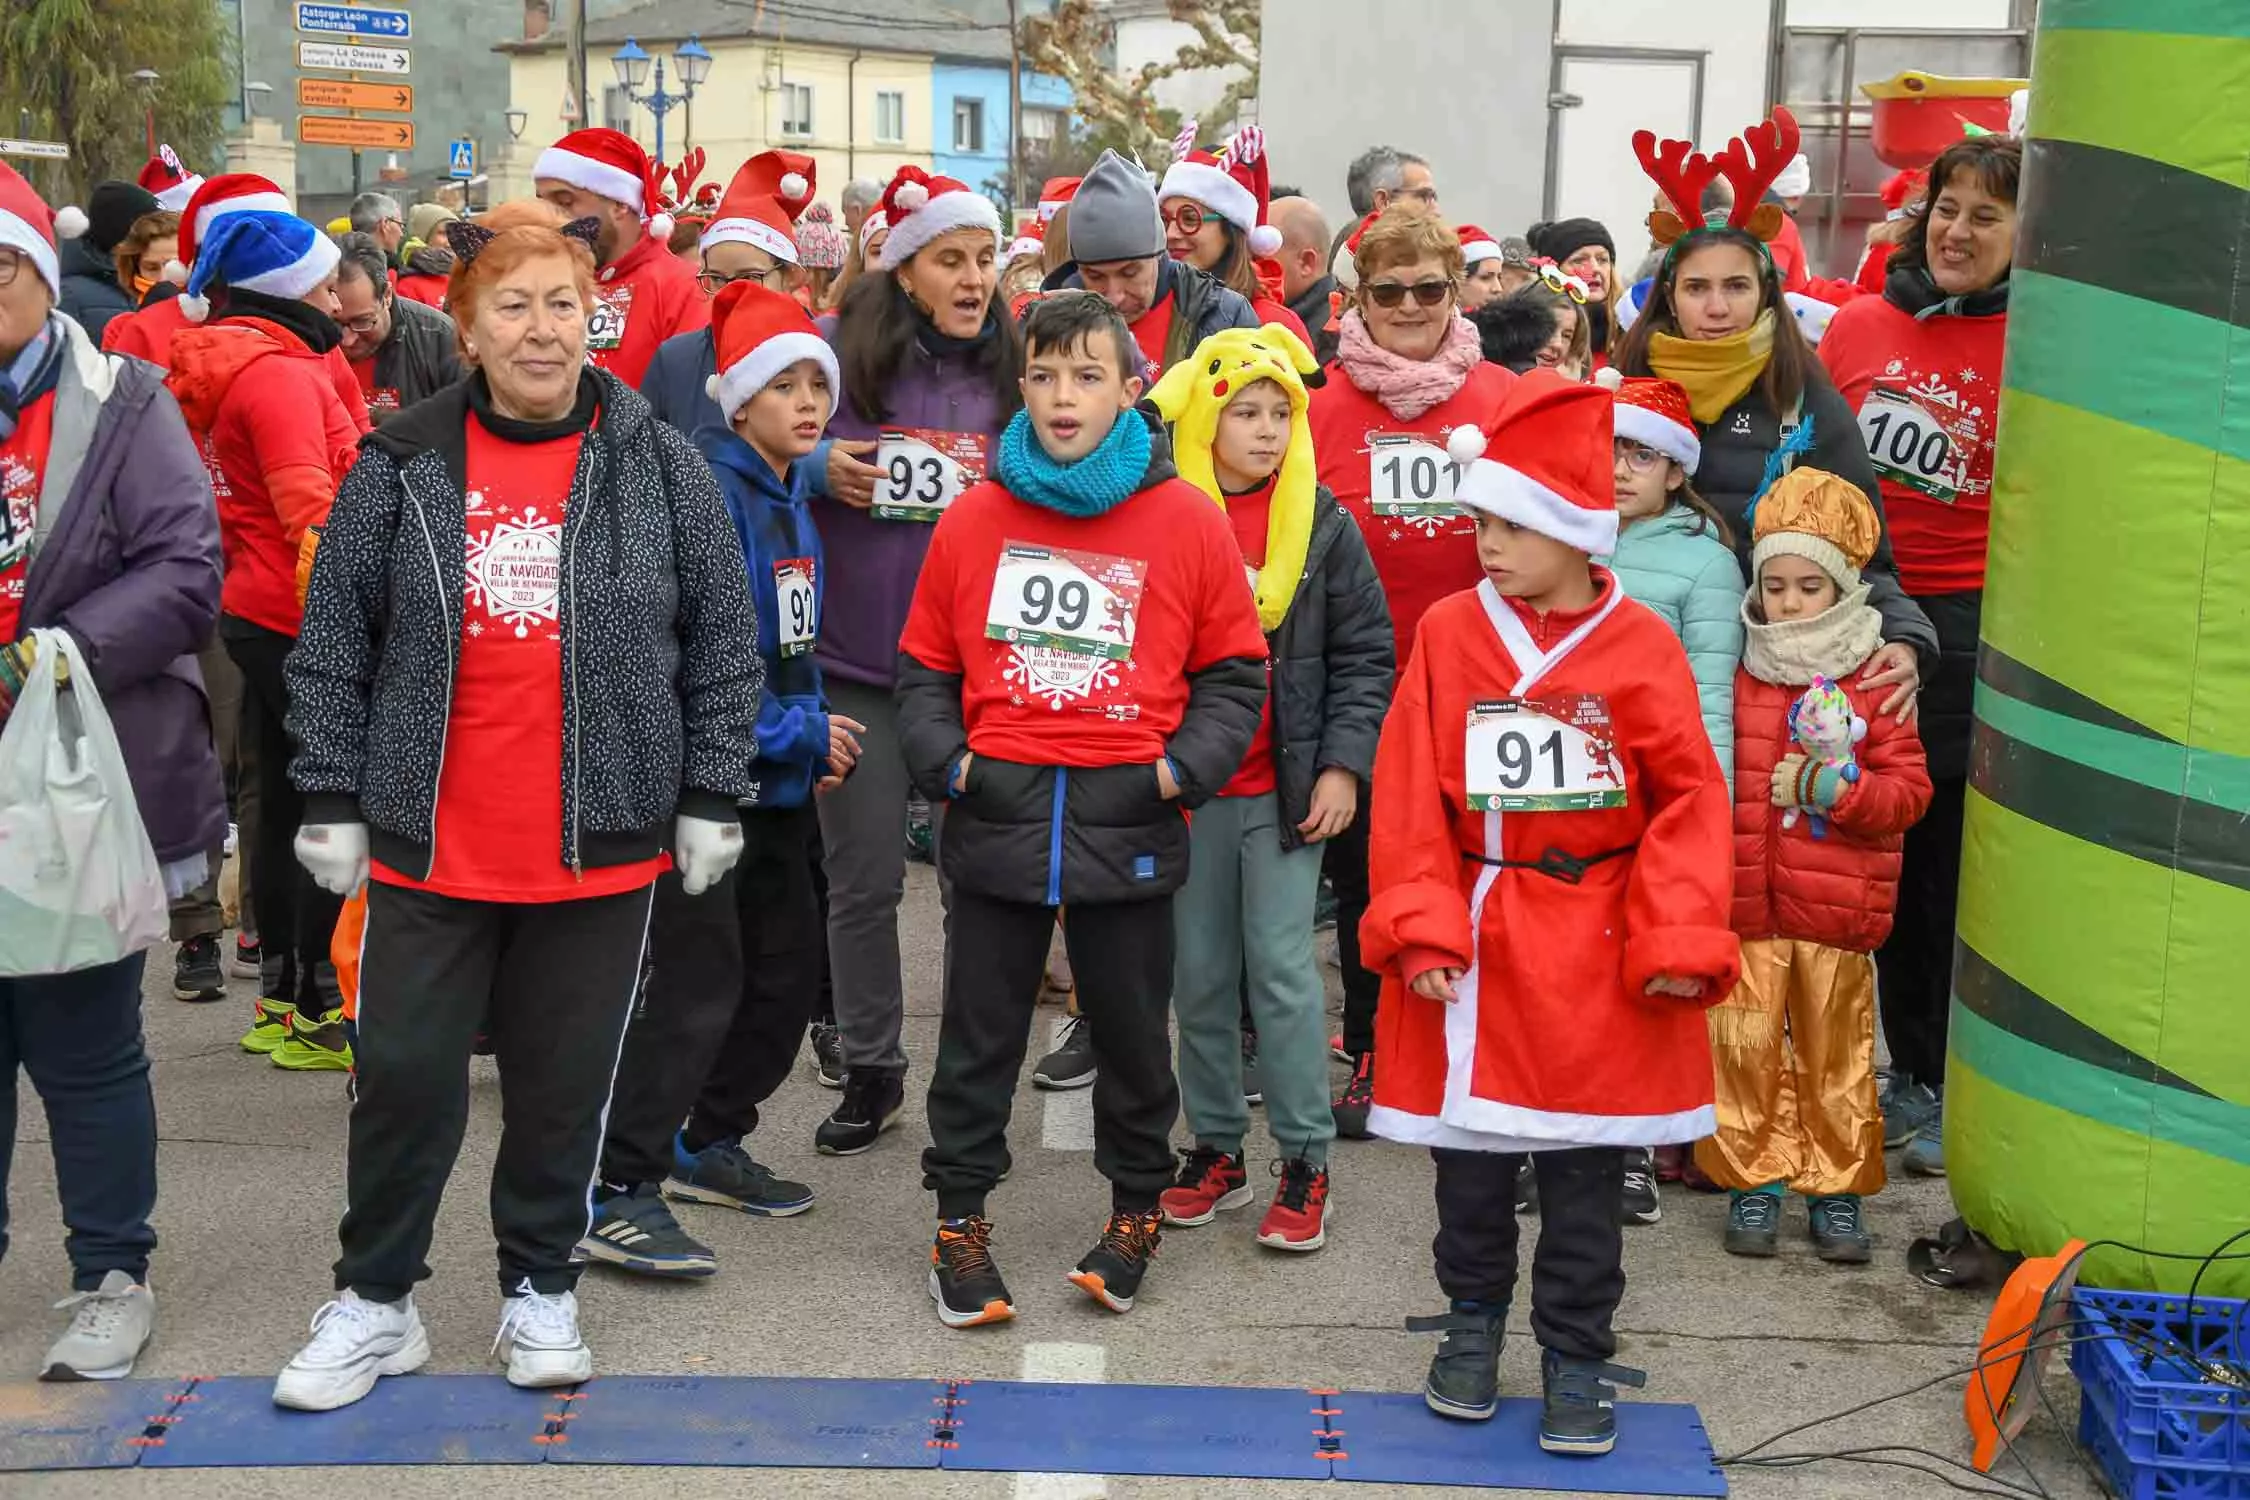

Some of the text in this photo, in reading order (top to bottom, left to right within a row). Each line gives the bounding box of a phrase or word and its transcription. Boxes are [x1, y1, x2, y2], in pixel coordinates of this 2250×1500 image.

[1869, 412, 1949, 475] 100
[889, 455, 943, 503] 93
[1382, 456, 1461, 499] 101
[491, 563, 559, 580] DE NAVIDAD
[491, 579, 508, 588] VILLA
[511, 579, 519, 588] DE
[512, 590, 534, 602] 2023
[791, 586, 814, 637] 92
[1020, 575, 1090, 631] 99
[1051, 671, 1070, 681] 2023
[1497, 730, 1565, 789] 91
